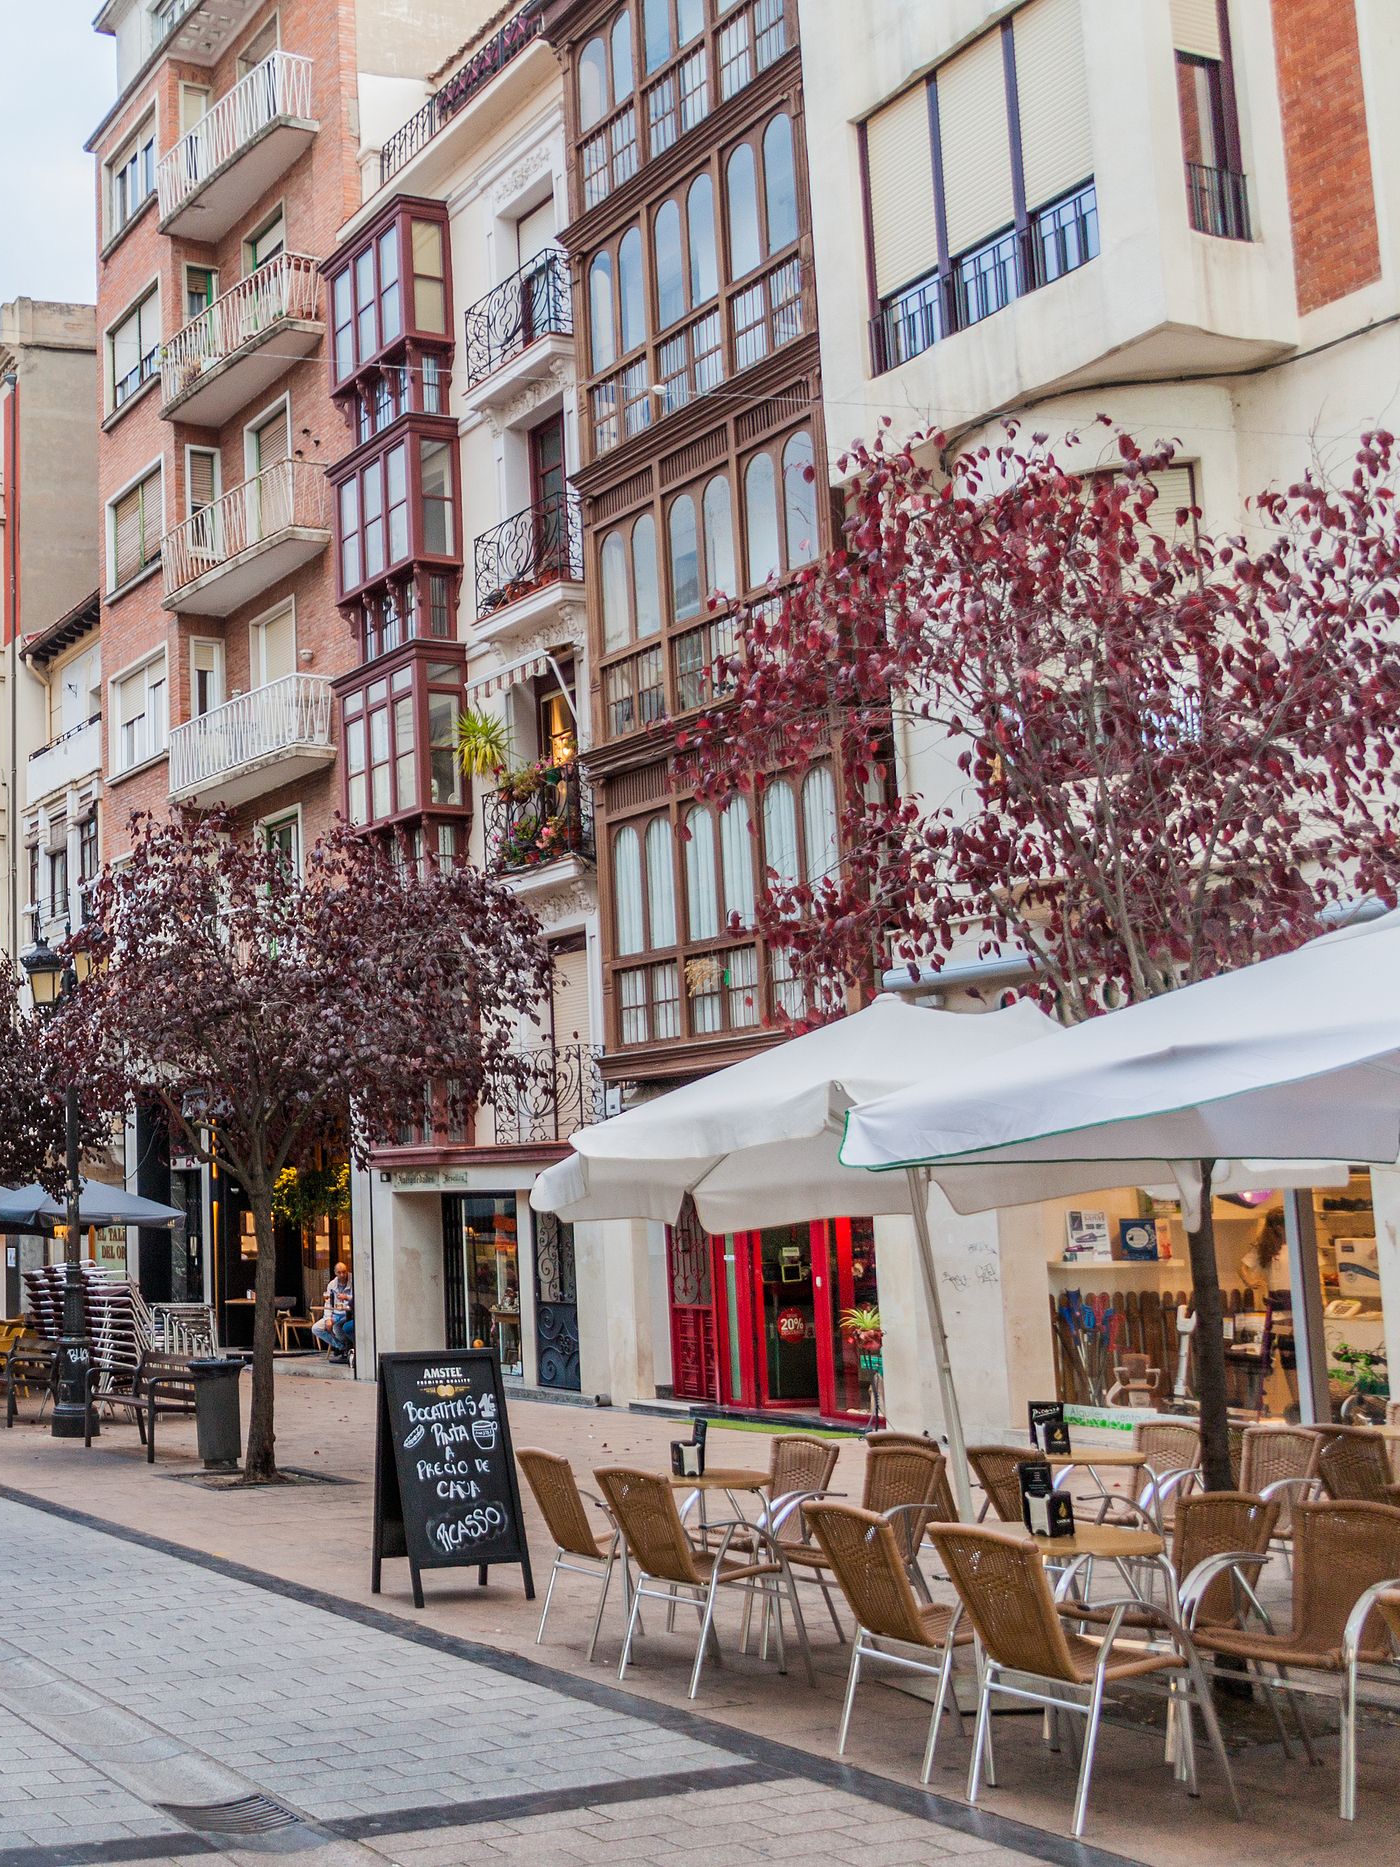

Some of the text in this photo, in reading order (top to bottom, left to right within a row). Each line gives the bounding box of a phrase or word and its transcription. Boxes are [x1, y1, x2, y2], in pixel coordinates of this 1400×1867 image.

[102, 1245, 115, 1259] DEL
[780, 1318, 804, 1331] 20%
[423, 1367, 463, 1379] AMSTEL
[403, 1395, 476, 1423] BOCATITAS
[430, 1422, 470, 1447] PINTA
[445, 1445, 456, 1461] A
[416, 1458, 491, 1481] PRECIO DE
[436, 1480, 481, 1499] CAÑA
[436, 1506, 501, 1552] PICASSO
